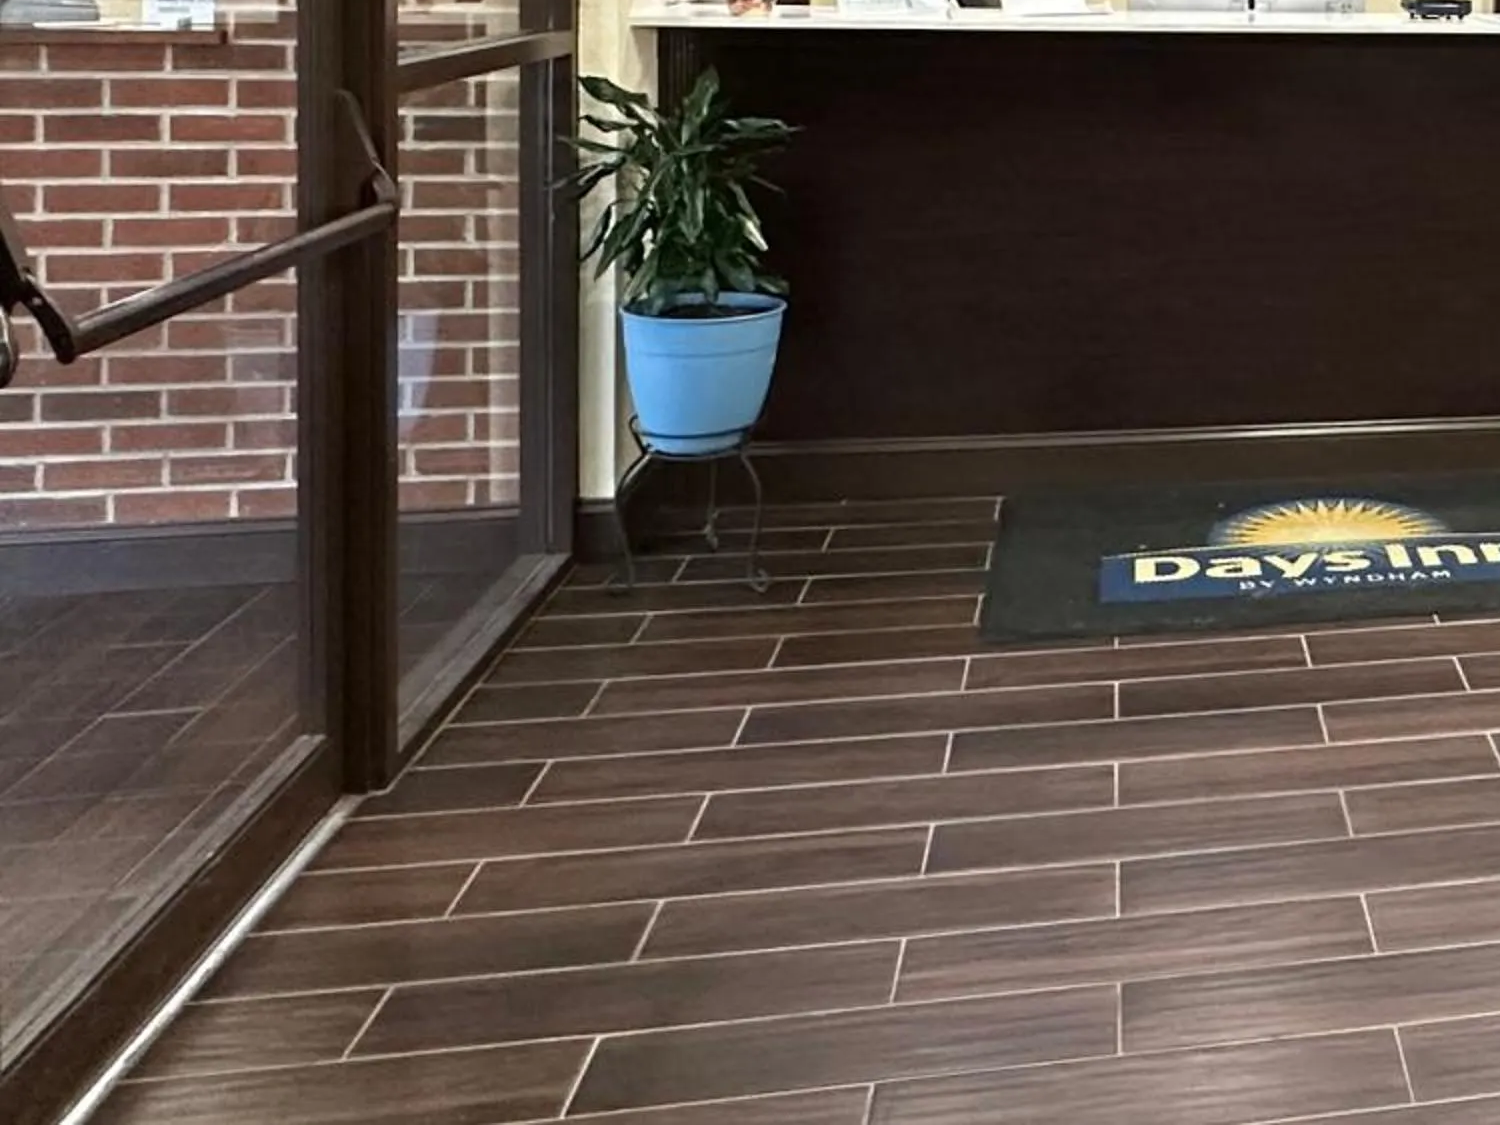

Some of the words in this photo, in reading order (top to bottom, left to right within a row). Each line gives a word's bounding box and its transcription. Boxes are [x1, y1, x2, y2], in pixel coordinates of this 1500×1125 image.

[1134, 550, 1372, 584] Days
[1239, 579, 1275, 590] BY
[1294, 569, 1451, 588] WYNDHAM
